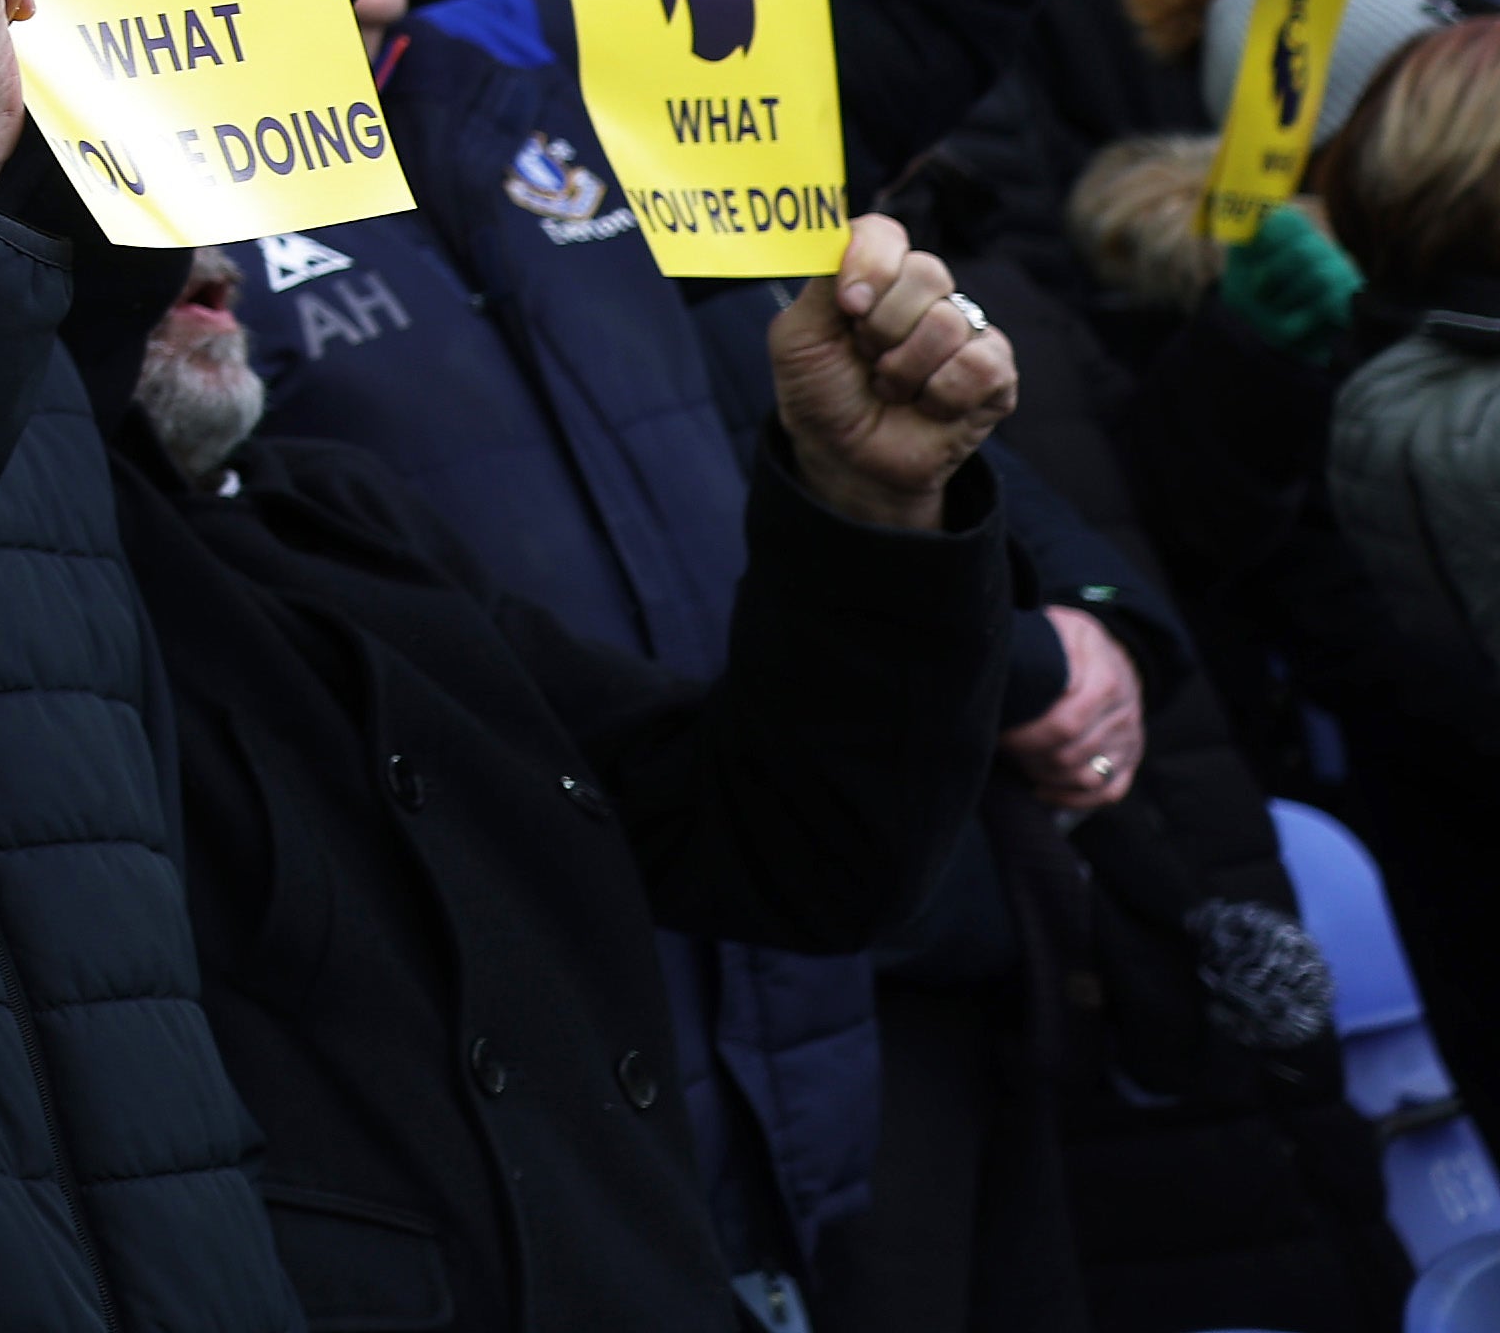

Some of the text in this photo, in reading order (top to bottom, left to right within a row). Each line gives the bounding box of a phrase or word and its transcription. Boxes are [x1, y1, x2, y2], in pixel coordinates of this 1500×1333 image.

[77, 2, 245, 81] WHAT
[214, 101, 385, 184] DOING
[667, 97, 780, 145] WHAT
[627, 185, 846, 233] YOU'RE DOIN
[294, 269, 413, 362] AH
